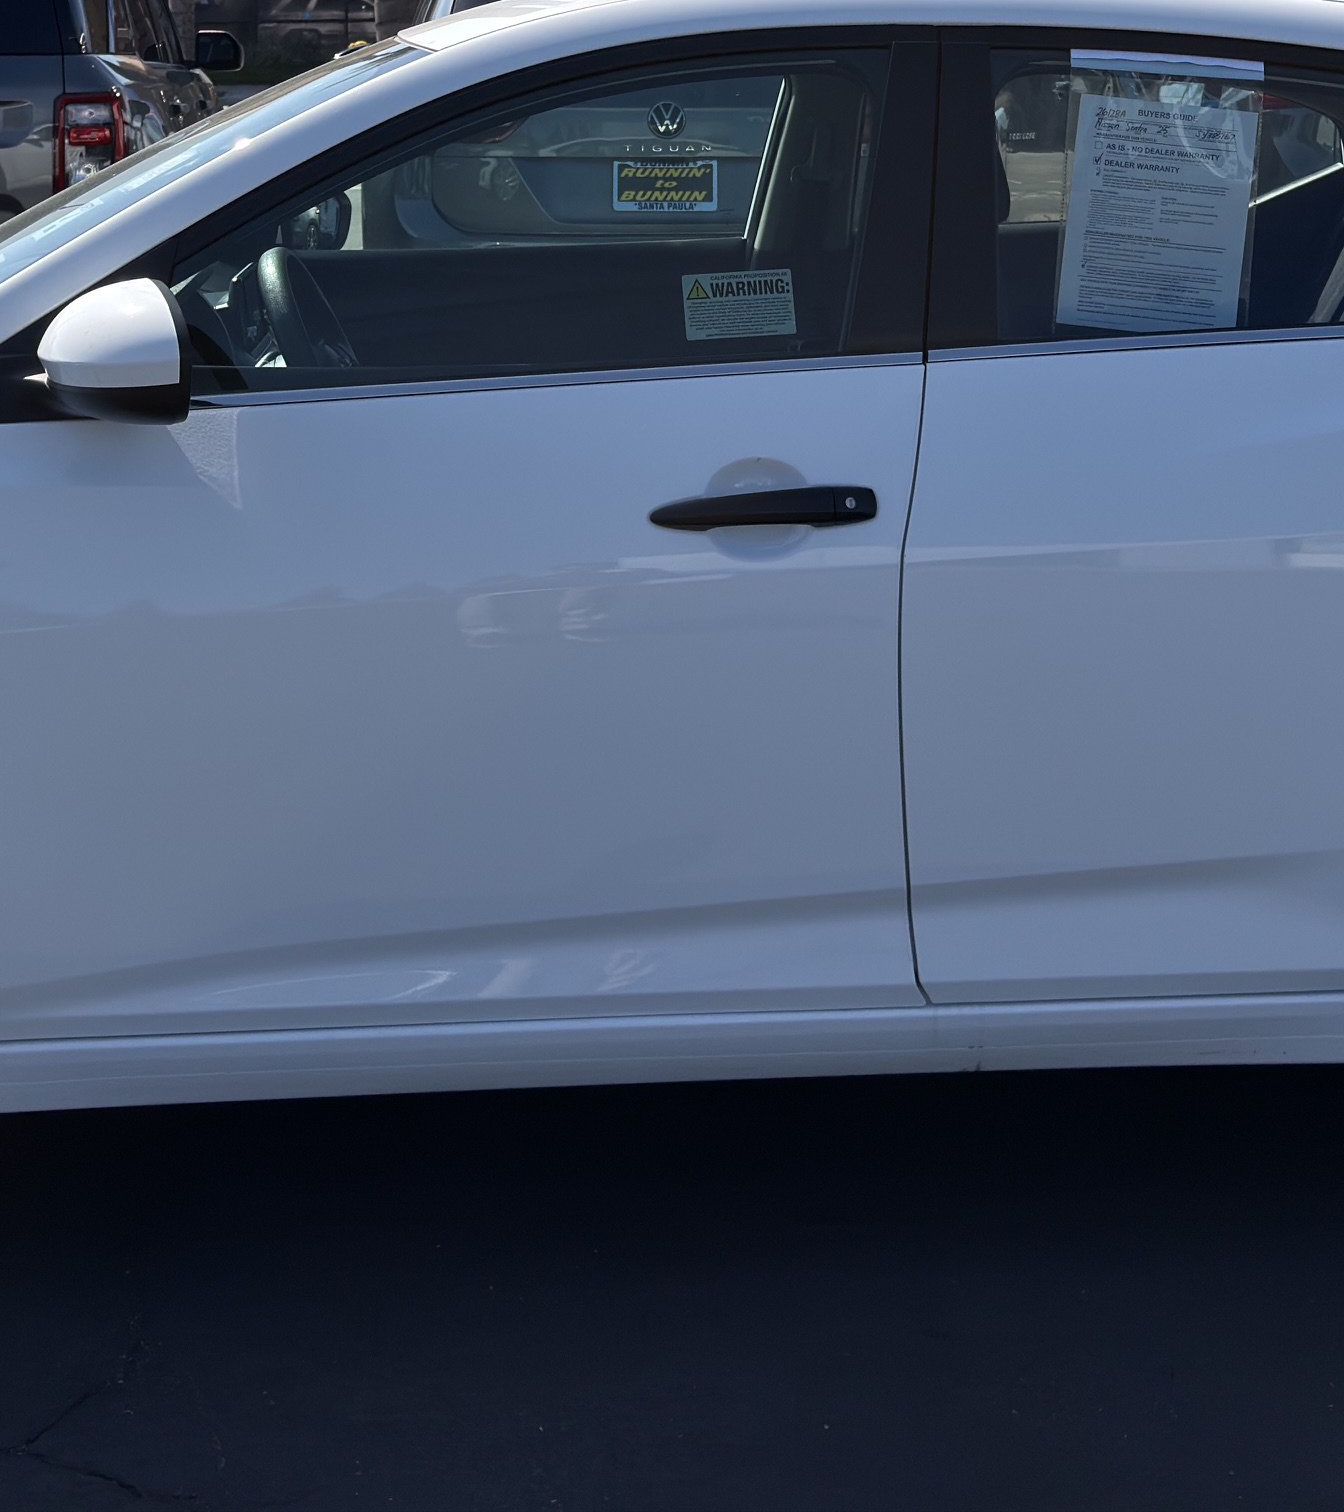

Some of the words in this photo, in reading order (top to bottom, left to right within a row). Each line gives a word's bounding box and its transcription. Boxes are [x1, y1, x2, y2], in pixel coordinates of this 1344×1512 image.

[1138, 109, 1171, 120] BUYERS
[1118, 144, 1126, 152] IS
[1144, 147, 1175, 157] DEALER
[1104, 159, 1135, 169] DEALER
[1136, 163, 1180, 173] WARRANTY
[620, 168, 711, 177] RUNNIN'
[655, 180, 677, 188] to
[619, 191, 707, 201] BUNNIN
[710, 278, 790, 298] WARNING:
